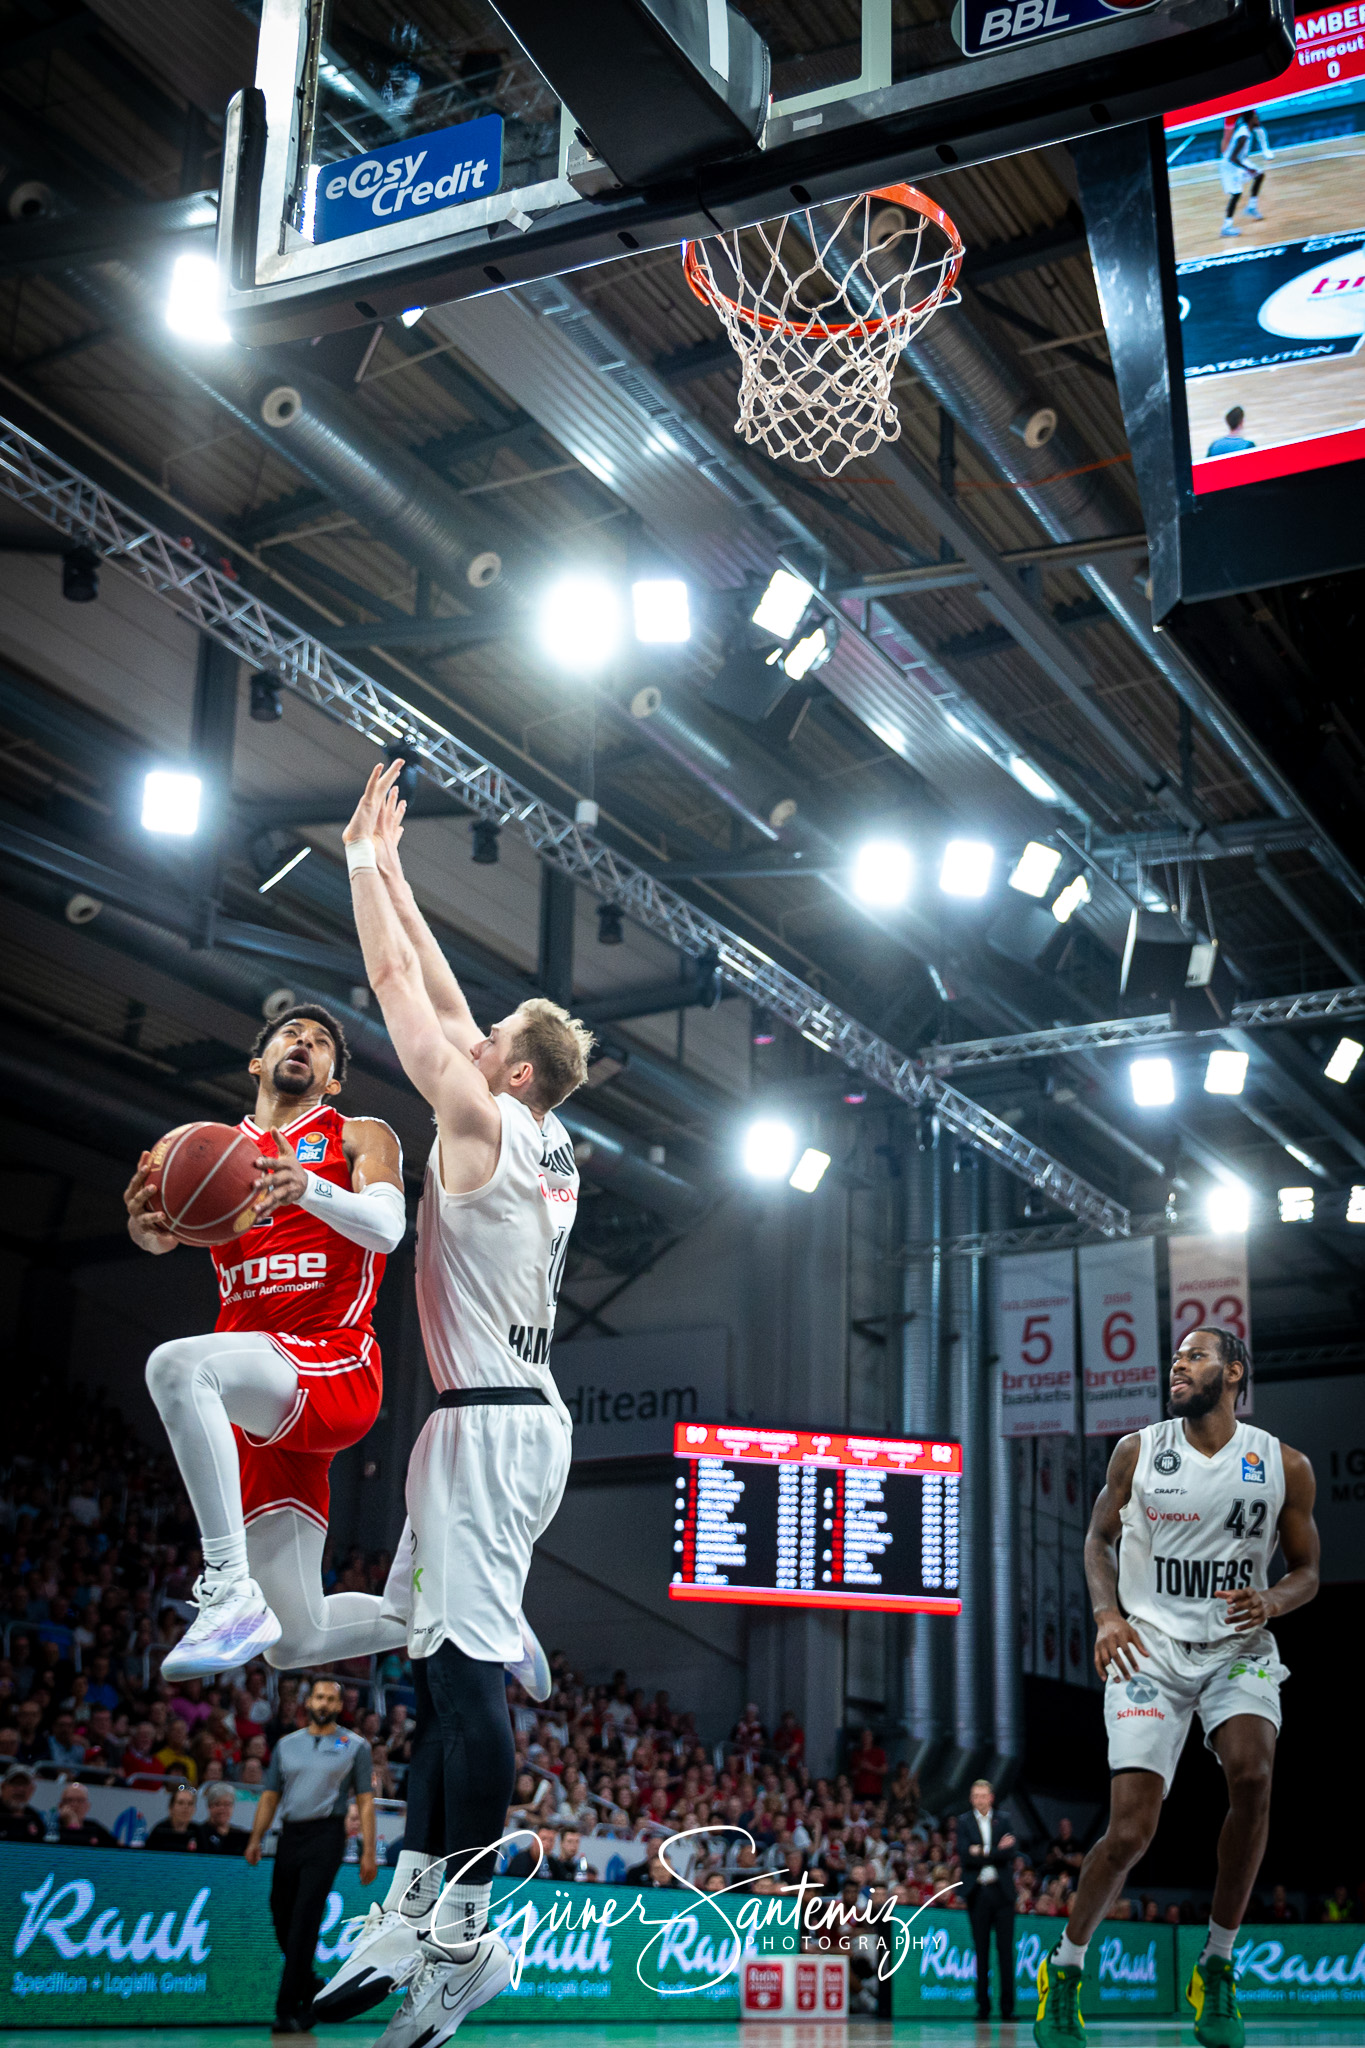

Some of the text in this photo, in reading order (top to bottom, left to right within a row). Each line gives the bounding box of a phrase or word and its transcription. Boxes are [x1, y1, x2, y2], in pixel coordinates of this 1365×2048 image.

[979, 0, 1070, 46] BBL
[1327, 60, 1340, 79] 0
[372, 158, 489, 217] Credit
[299, 1151, 321, 1161] BBL
[219, 1252, 327, 1298] brose
[243, 1289, 257, 1299] für
[1102, 1310, 1137, 1363] 6
[1175, 1294, 1246, 1350] 23
[1021, 1313, 1053, 1366] 5
[1002, 1369, 1071, 1389] brose
[1084, 1365, 1157, 1388] brose
[1084, 1384, 1158, 1402] bamberg
[1002, 1388, 1072, 1406] baskets
[1154, 1487, 1180, 1495] CRAFT
[1159, 1512, 1201, 1522] VEOLIA
[1223, 1498, 1268, 1539] 42
[1154, 1555, 1253, 1598] TOWERS
[12, 1872, 212, 1964] Rauh
[1098, 1935, 1158, 1983] Rauh
[11, 1971, 88, 1999] Spedition
[103, 1972, 157, 1999] Logistik
[159, 1972, 207, 1994] GmbH
